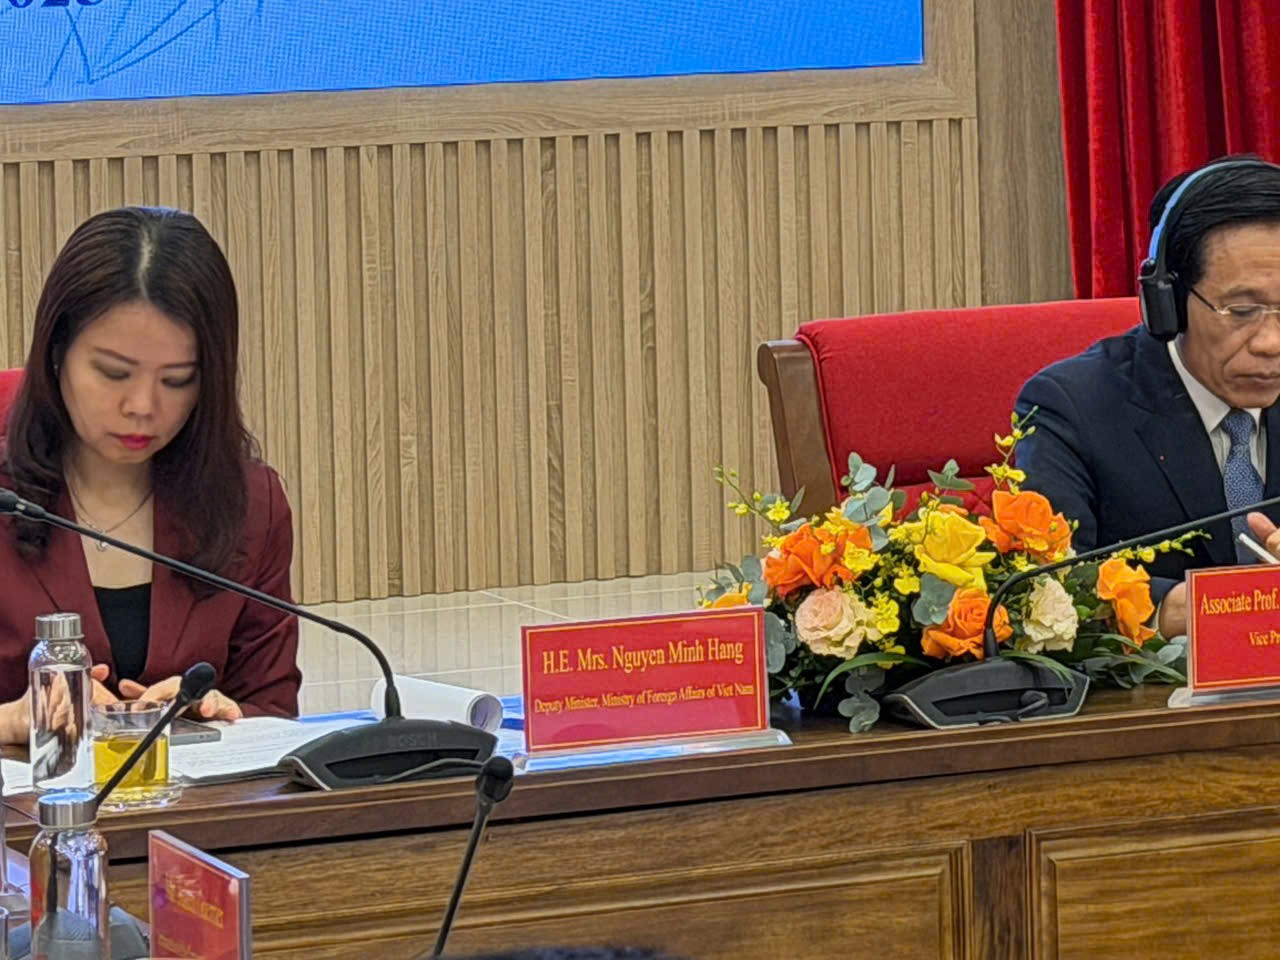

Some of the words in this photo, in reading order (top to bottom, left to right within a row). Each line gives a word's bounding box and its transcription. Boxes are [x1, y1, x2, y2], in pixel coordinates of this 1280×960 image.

[1200, 591, 1252, 616] Associate
[1254, 588, 1279, 611] Prof.
[1250, 631, 1269, 646] Vice
[543, 649, 573, 675] H.E.
[577, 648, 608, 672] Mrs.
[612, 644, 666, 674] Nguyen
[668, 640, 704, 663] Minh
[708, 637, 744, 665] Hang
[636, 691, 646, 705] of
[706, 685, 716, 699] of
